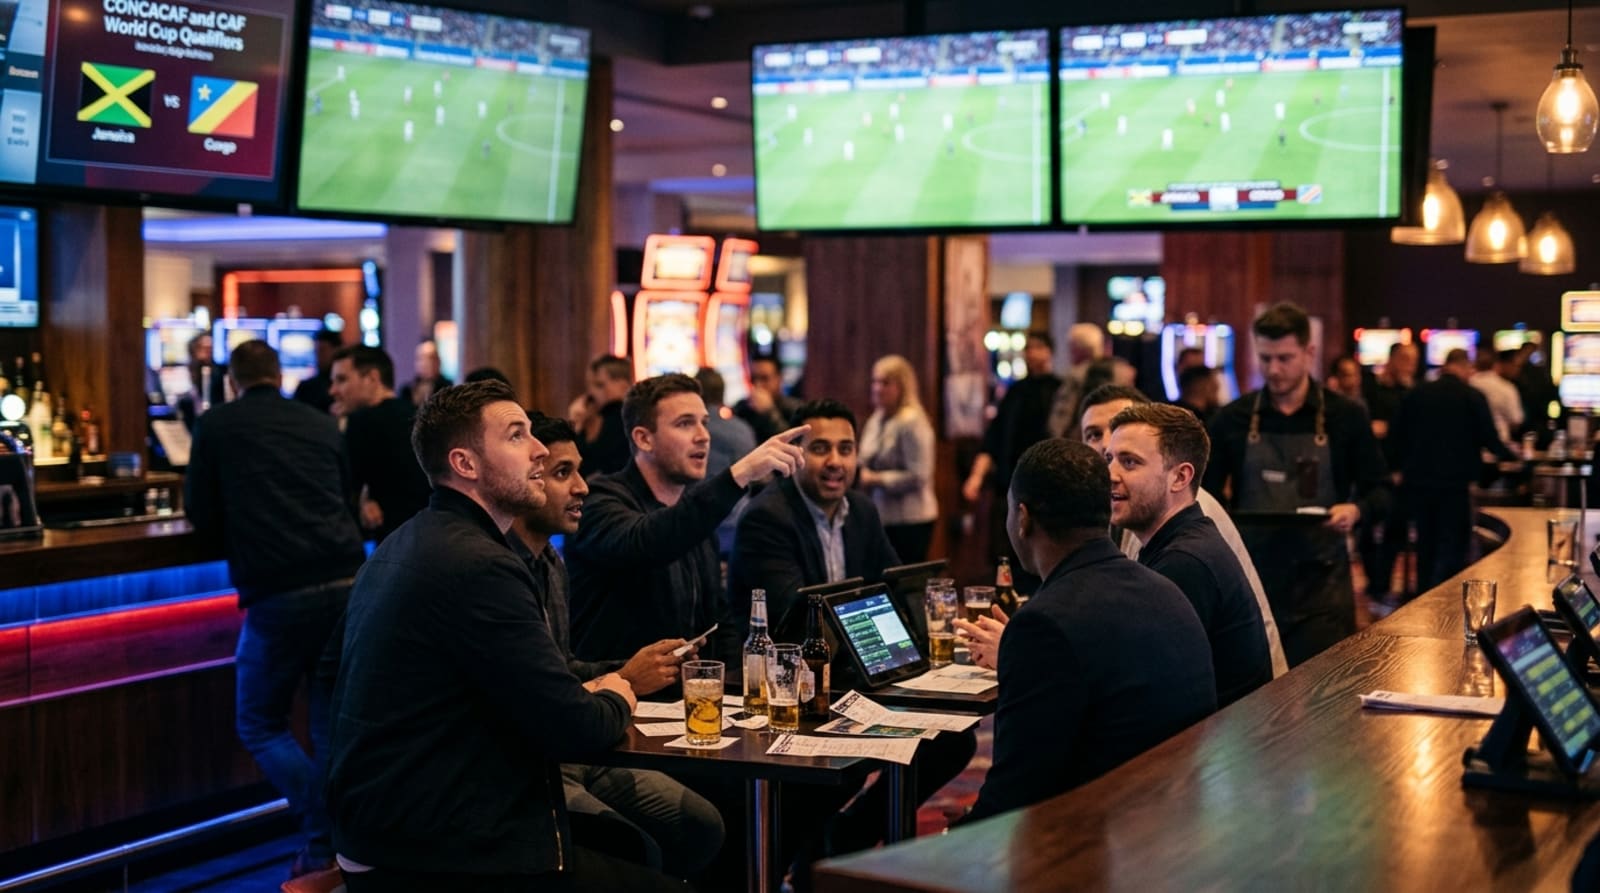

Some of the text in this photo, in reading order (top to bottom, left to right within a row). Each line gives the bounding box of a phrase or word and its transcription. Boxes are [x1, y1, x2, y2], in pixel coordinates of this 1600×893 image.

[103, 0, 247, 31] CONCACAF and CAF
[104, 15, 147, 37] World
[149, 22, 178, 45] Cup
[180, 26, 244, 51] Qualifiers
